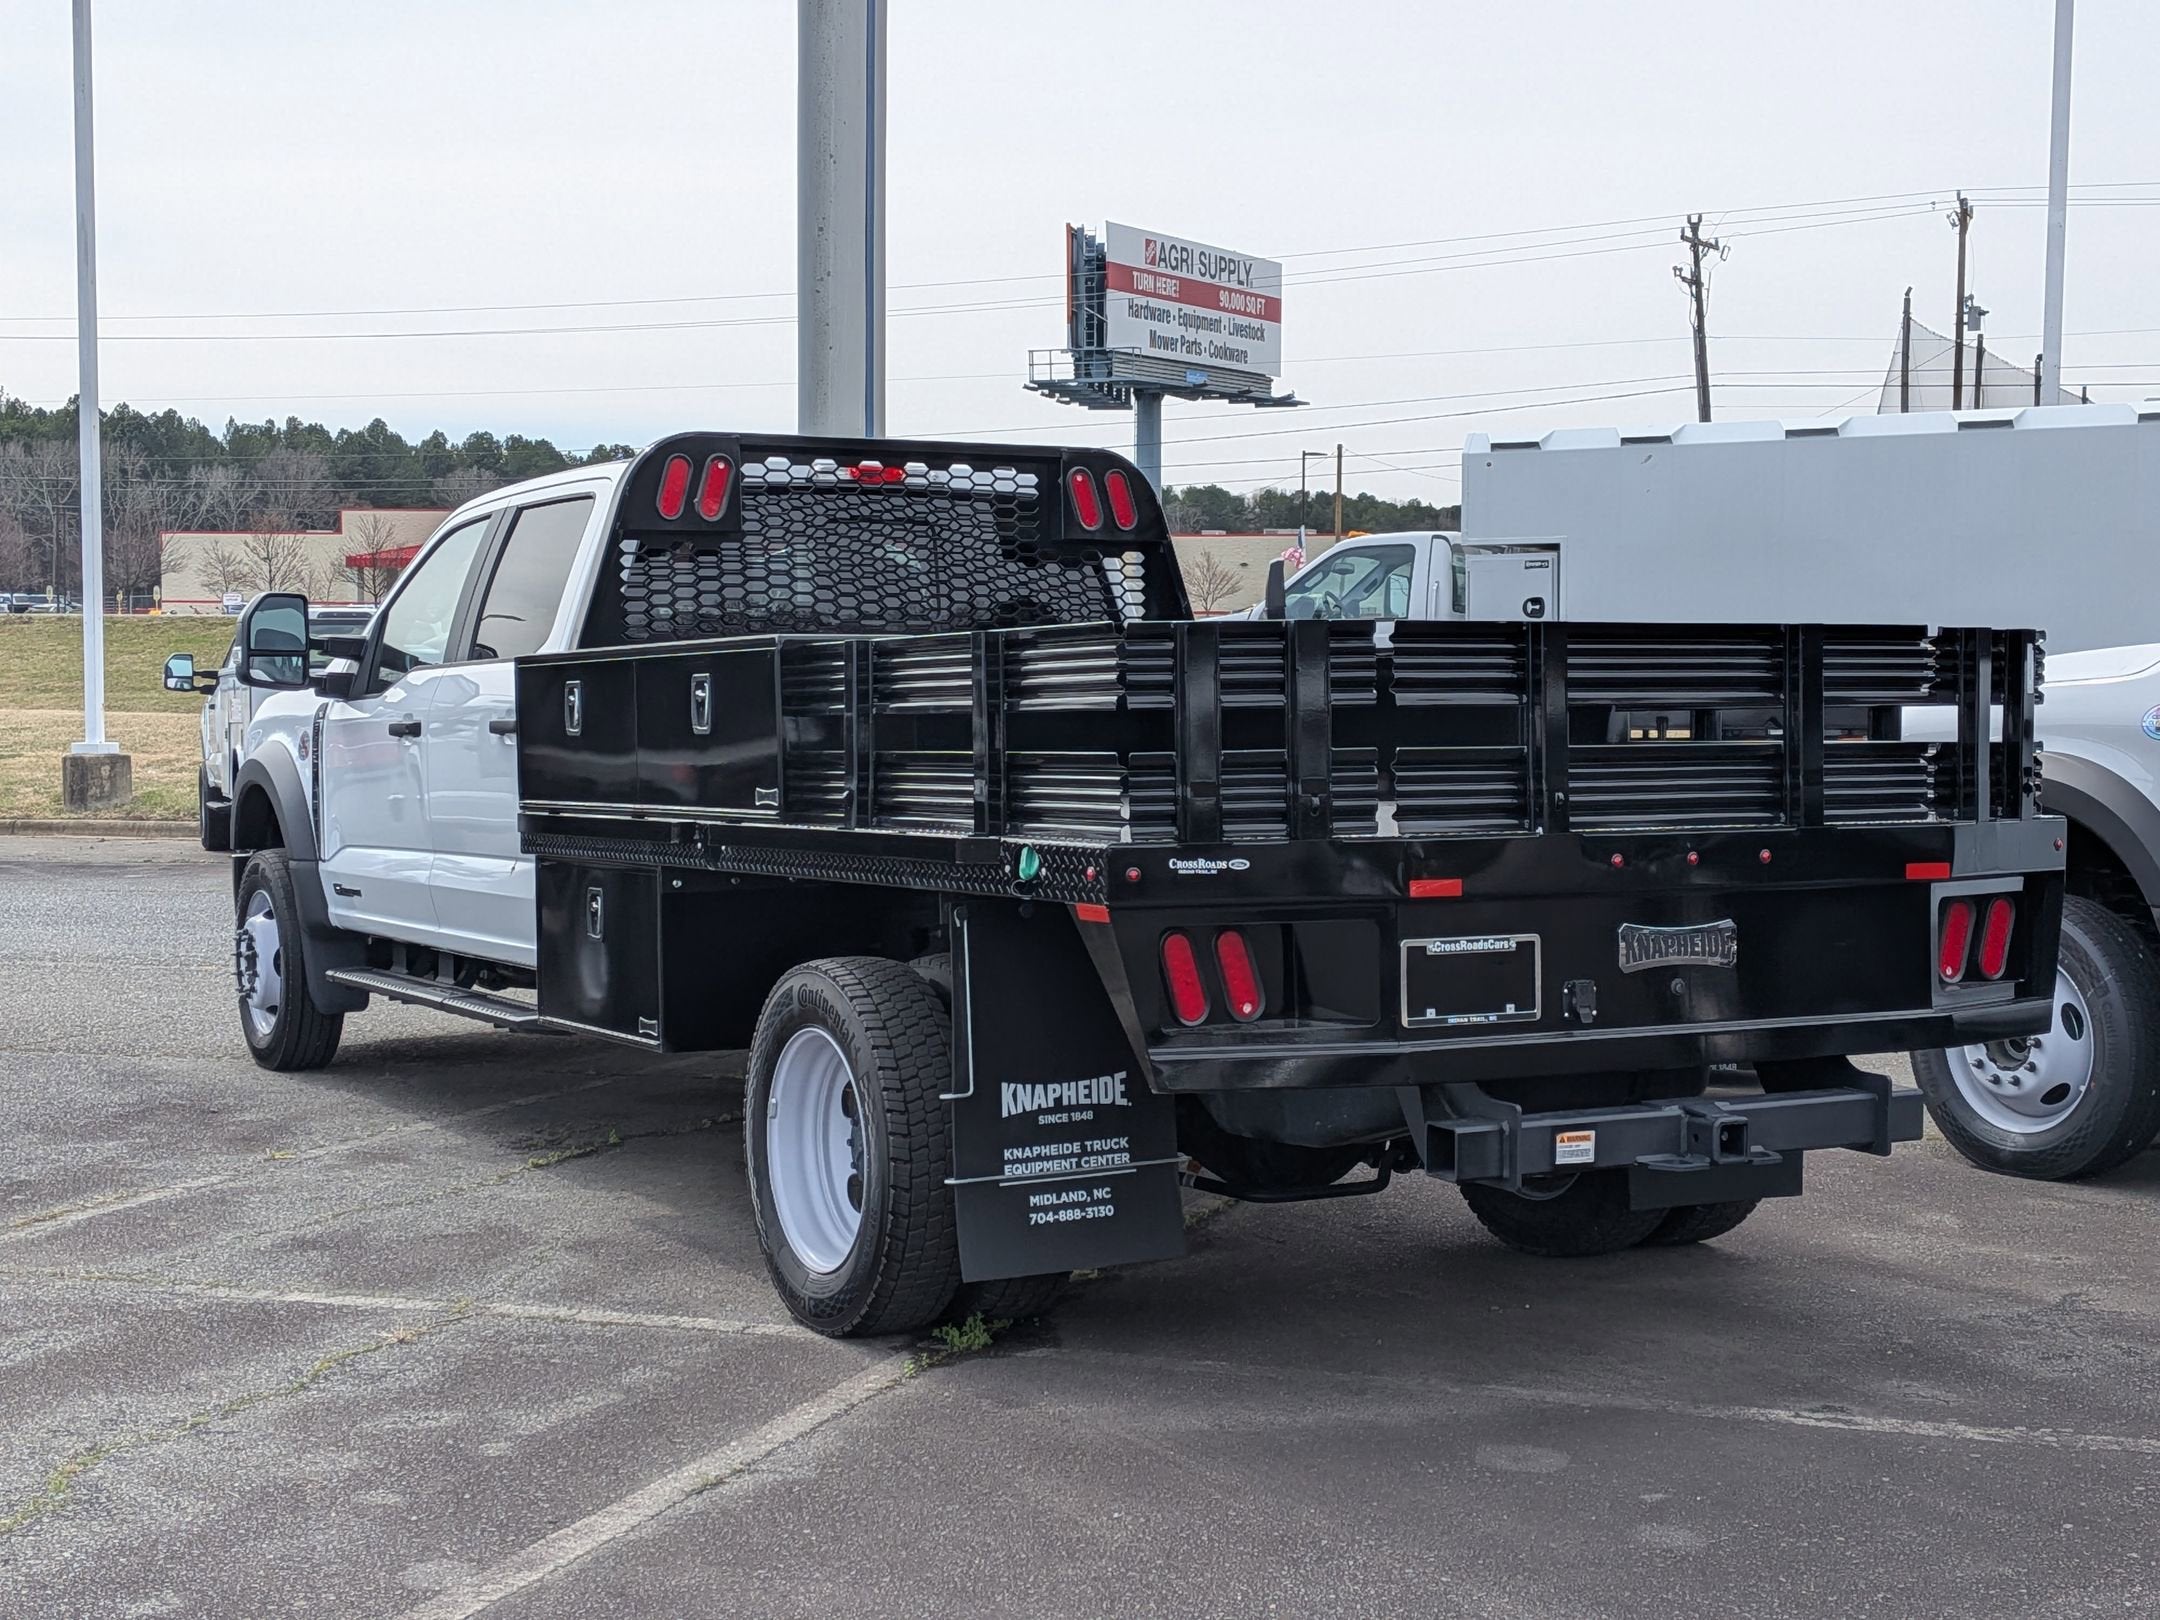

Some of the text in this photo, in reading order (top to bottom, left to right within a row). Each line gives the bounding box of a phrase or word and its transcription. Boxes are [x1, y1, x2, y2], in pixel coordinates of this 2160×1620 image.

[1157, 241, 1194, 275] AGRI
[1132, 271, 1180, 298] TURN HERE!
[1219, 291, 1266, 316] 90,000 SQ FT
[1127, 297, 1266, 342] Hardware Equipment Livestock
[1149, 328, 1249, 364] Mower Parts Cookware
[1624, 928, 1733, 966] KNAPHEIDE
[797, 982, 856, 1047] Continental
[1038, 1110, 1094, 1125] SINCE 1848
[1003, 1136, 1129, 1161] KNAPHEIDE TRUCK
[1003, 1152, 1131, 1177] EQUIPMENT CENTER
[1029, 1187, 1112, 1208] MIDLAND, NC
[1029, 1205, 1115, 1226] 704-888-3130
